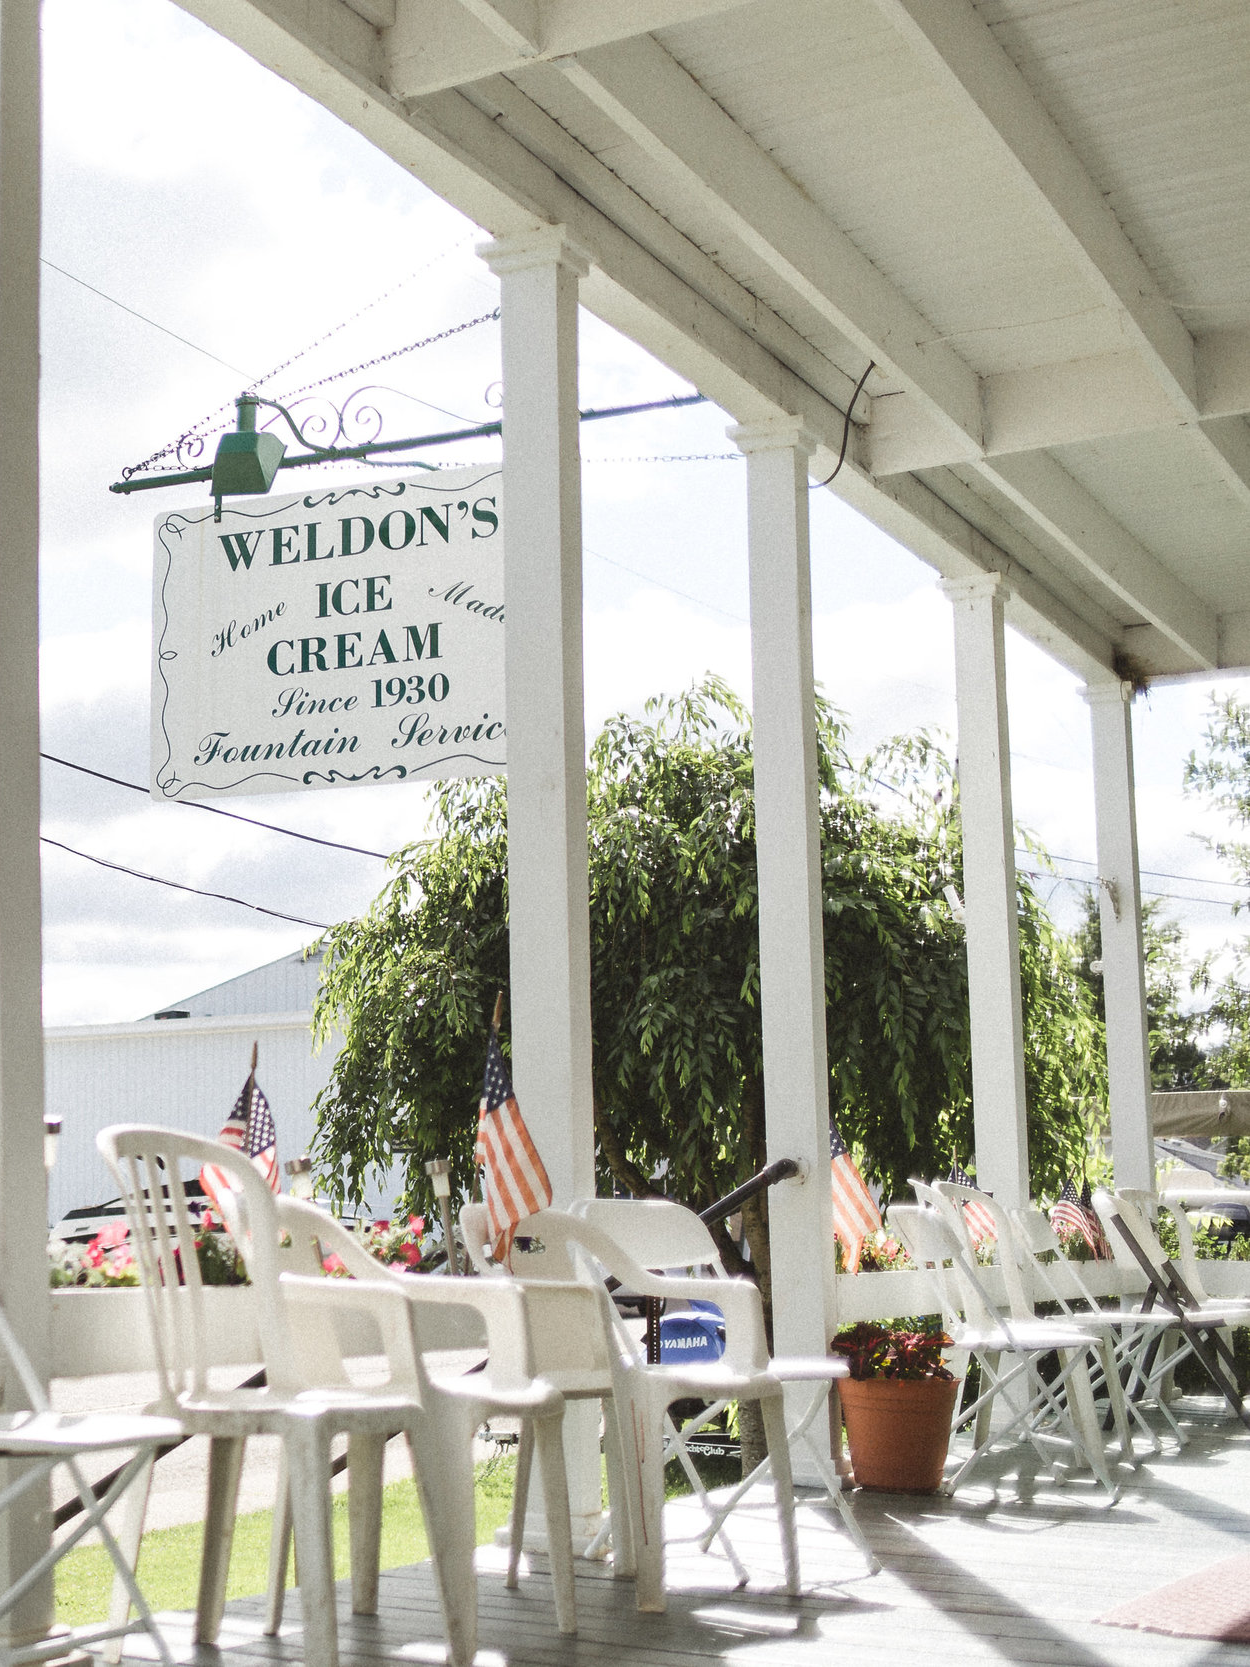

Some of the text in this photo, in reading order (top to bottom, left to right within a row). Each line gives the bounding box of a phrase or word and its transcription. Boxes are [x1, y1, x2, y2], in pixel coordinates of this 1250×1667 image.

[218, 496, 500, 572] WELDON'S
[315, 575, 393, 619] ICE
[211, 601, 288, 658] Home
[267, 622, 444, 676] CREAM
[271, 672, 450, 718] Since 1930
[193, 713, 508, 766] Fountain Servic
[664, 1335, 708, 1349] YAMAHA
